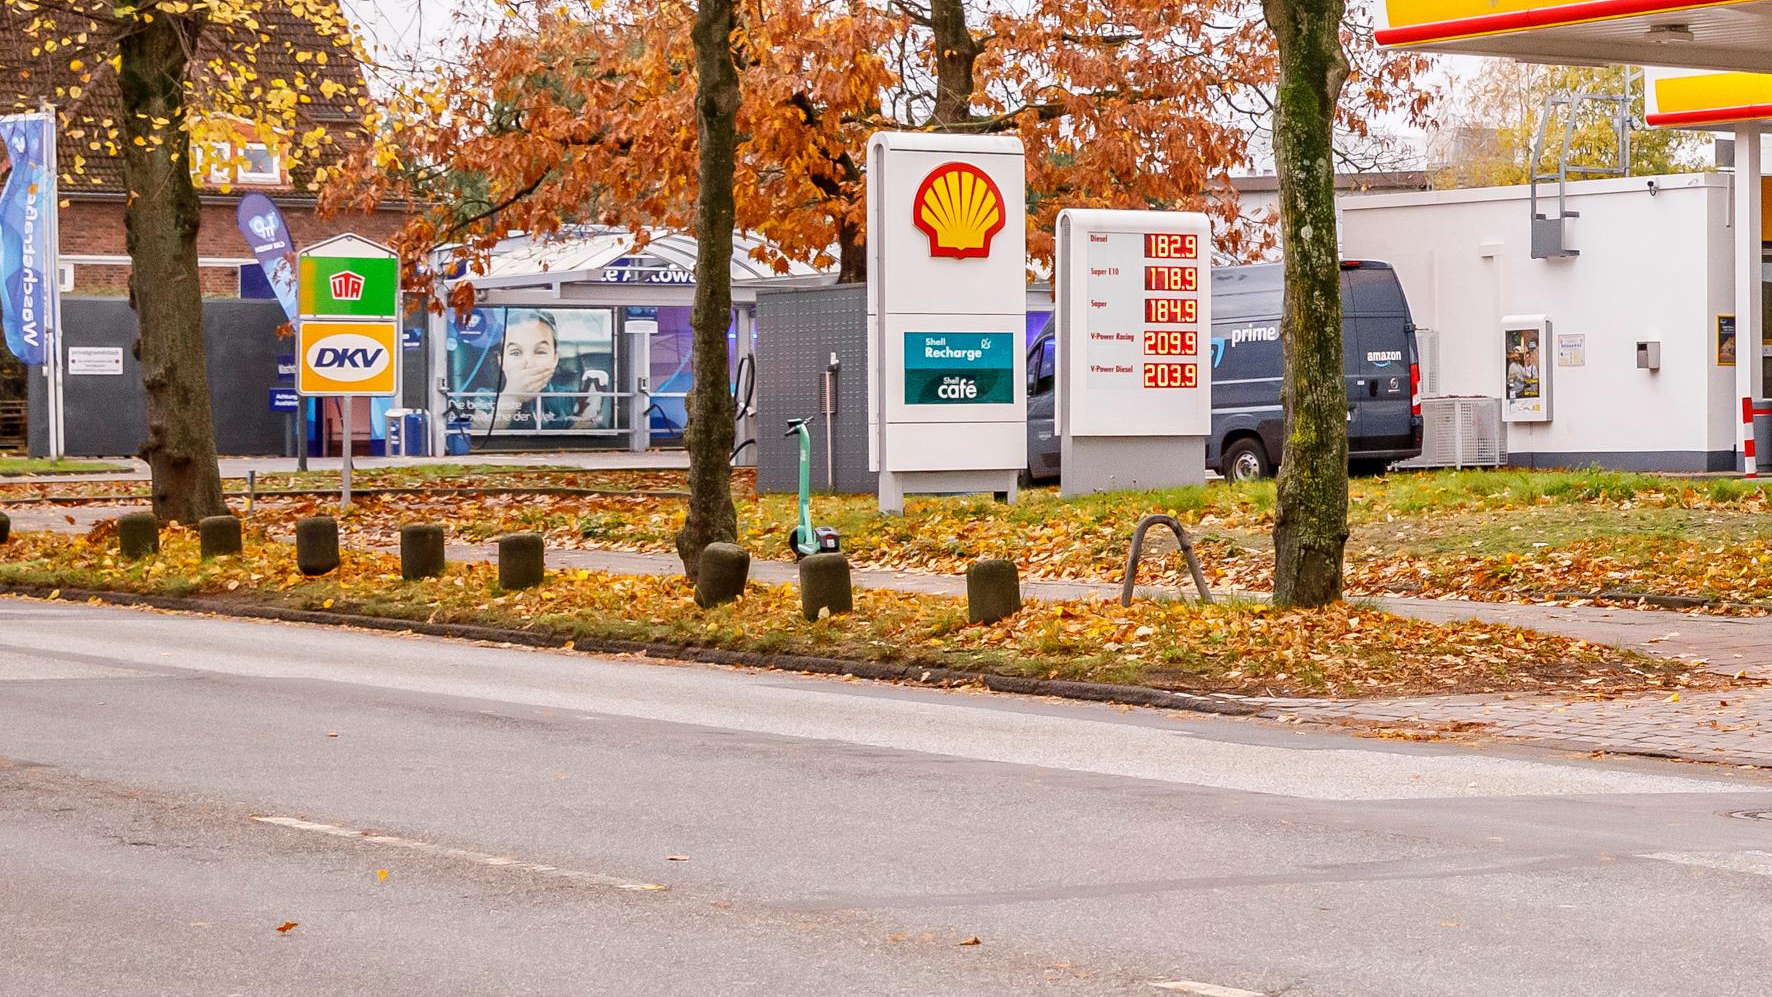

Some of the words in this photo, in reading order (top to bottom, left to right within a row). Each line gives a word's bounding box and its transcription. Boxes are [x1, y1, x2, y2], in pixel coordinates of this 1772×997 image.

[1090, 234, 1108, 243] Diesel
[1150, 235, 1196, 257] 182.9
[331, 271, 363, 299] UTA
[1090, 268, 1107, 277] Super
[1150, 267, 1196, 290] 178.9
[1090, 300, 1107, 308] Super
[1150, 300, 1196, 322] 184.9
[925, 337, 946, 346] Shell
[1115, 334, 1134, 342] Racing
[1144, 332, 1196, 354] 209.9
[1231, 323, 1279, 347] prime
[314, 348, 383, 368] DKV
[925, 346, 982, 361] Recharge
[1367, 351, 1401, 362] amazon
[1090, 365, 1114, 373] V-Power
[1115, 365, 1133, 373] Diesel
[1144, 364, 1196, 387] 203.9
[938, 379, 977, 398] café
